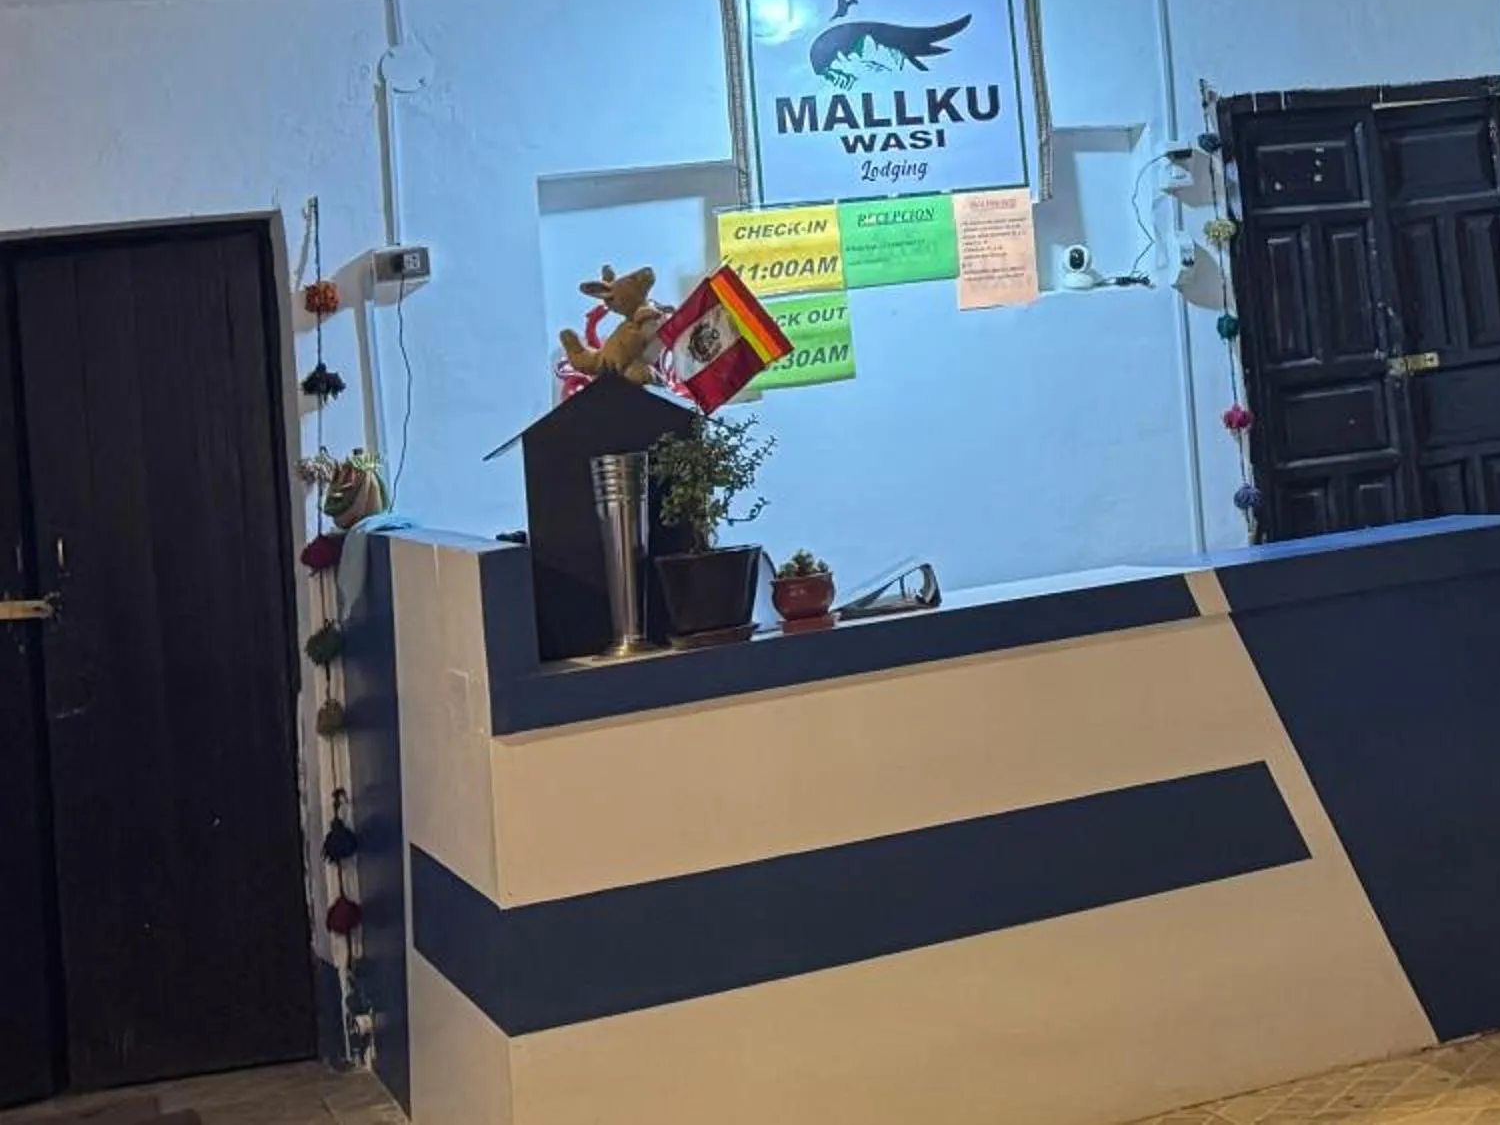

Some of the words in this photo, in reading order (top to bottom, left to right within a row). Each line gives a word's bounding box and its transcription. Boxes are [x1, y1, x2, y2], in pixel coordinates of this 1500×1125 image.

[775, 84, 1001, 134] MALLKU
[841, 129, 946, 154] WASI
[861, 159, 928, 182] Lodging
[734, 220, 827, 240] CHECK-IN
[735, 255, 839, 281] 11:00AM
[807, 306, 848, 323] OUT
